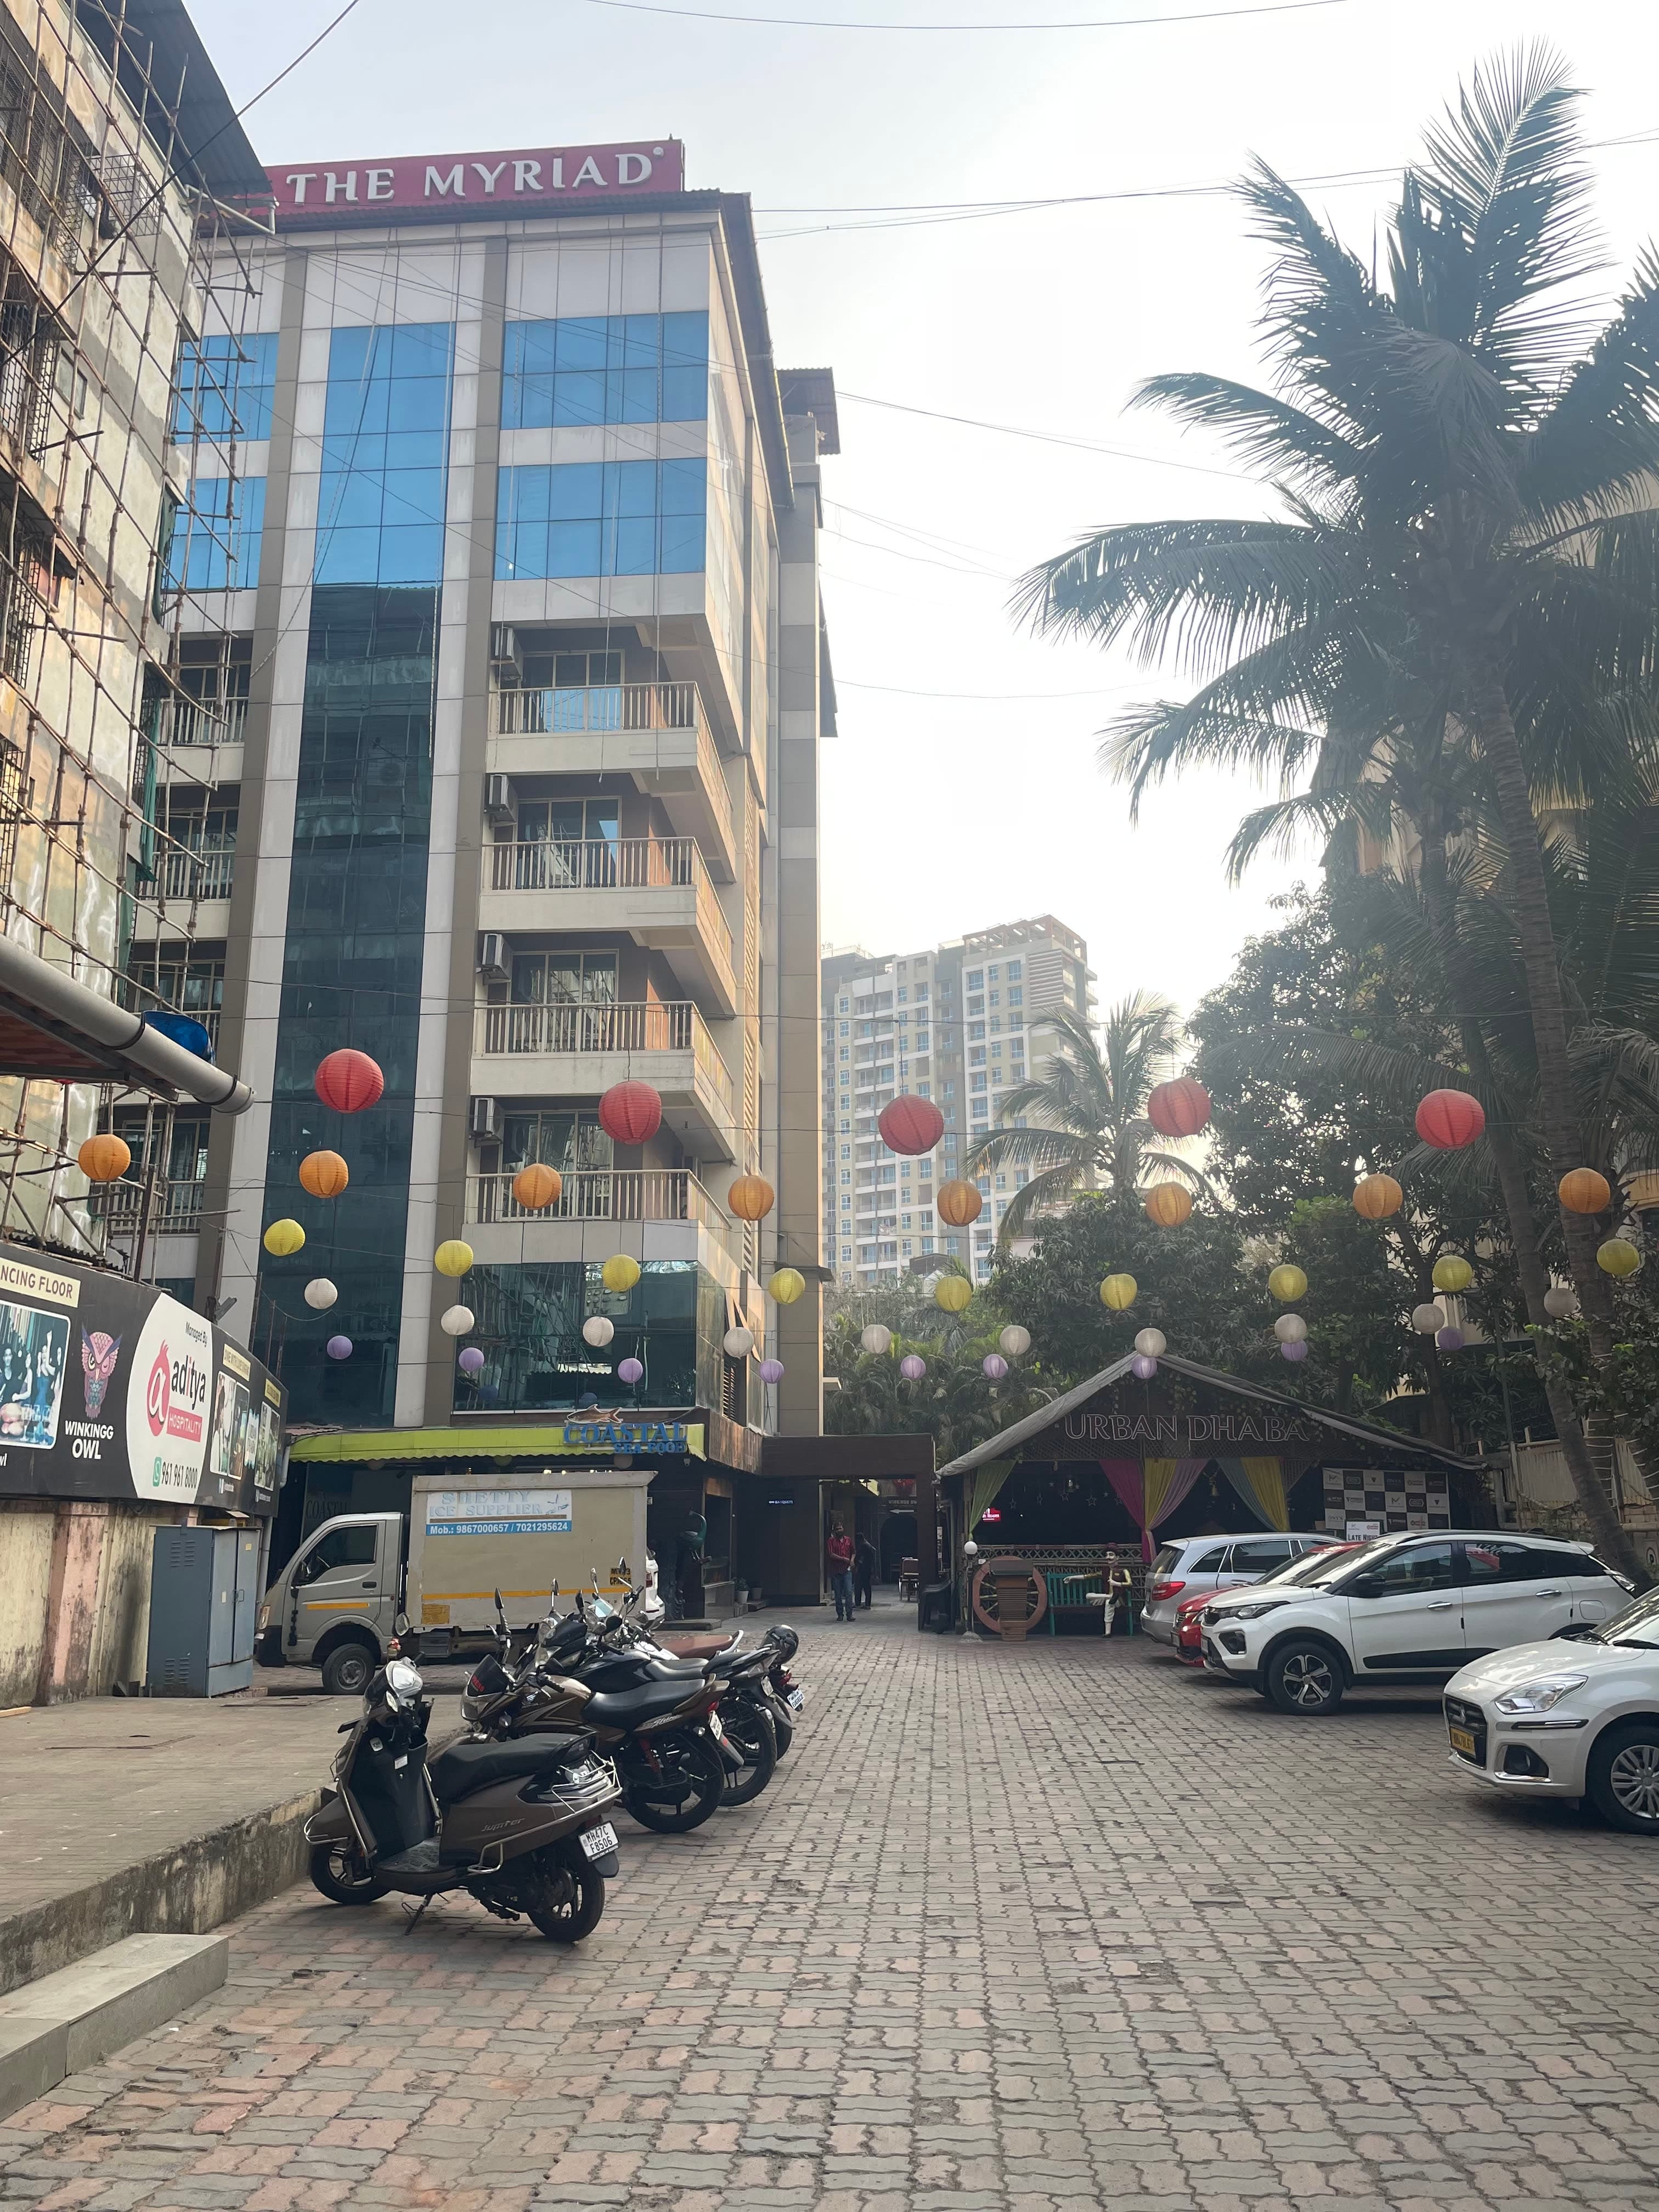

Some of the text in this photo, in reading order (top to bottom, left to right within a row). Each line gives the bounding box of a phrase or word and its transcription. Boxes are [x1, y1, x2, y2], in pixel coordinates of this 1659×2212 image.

[286, 149, 653, 207] THE MYRIAD
[1, 1265, 73, 1299] NCING FLOOR
[172, 1355, 206, 1410] aditya
[65, 1420, 114, 1440] WINKINGG
[169, 1413, 201, 1435] HOSPITALITY
[563, 1423, 687, 1444] COASTAL
[1064, 1413, 1309, 1442] URBAN DHABA
[72, 1438, 101, 1459] OWL
[614, 1442, 686, 1453] SEA FOOD
[161, 1462, 172, 1486] 961
[173, 1463, 184, 1487] 961
[184, 1465, 198, 1489] 8000
[442, 1490, 531, 1505] SHETTY
[430, 1503, 543, 1517] ICE SUPPLIER
[430, 1525, 454, 1534] Mob.:
[456, 1523, 509, 1534] 9867000657
[516, 1522, 568, 1532] 7021295624
[585, 1826, 608, 1843] MH47C
[590, 1836, 613, 1854] F8506
